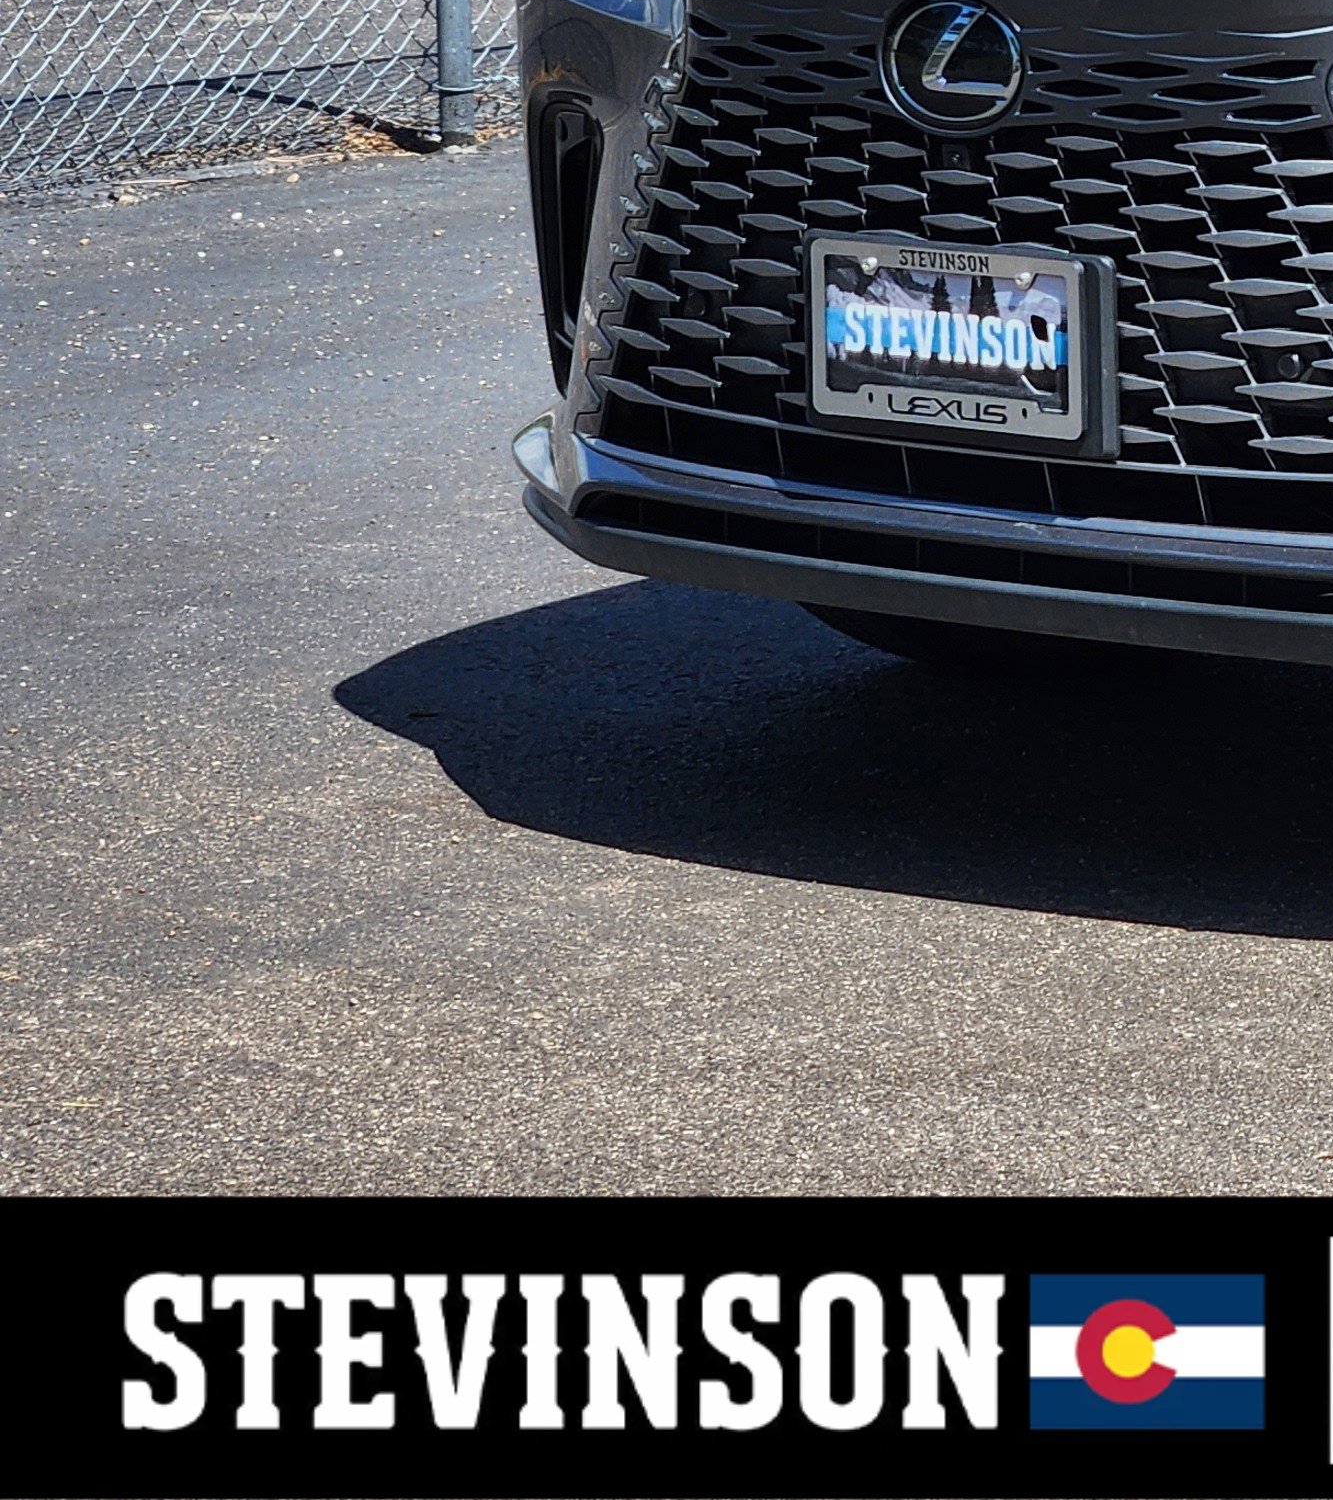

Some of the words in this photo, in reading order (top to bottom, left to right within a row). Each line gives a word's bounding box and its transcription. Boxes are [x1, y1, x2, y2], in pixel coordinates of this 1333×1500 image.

[898, 248, 990, 274] STEVINSON
[844, 302, 1057, 371] STEVINSON
[887, 393, 1008, 424] LEXUS
